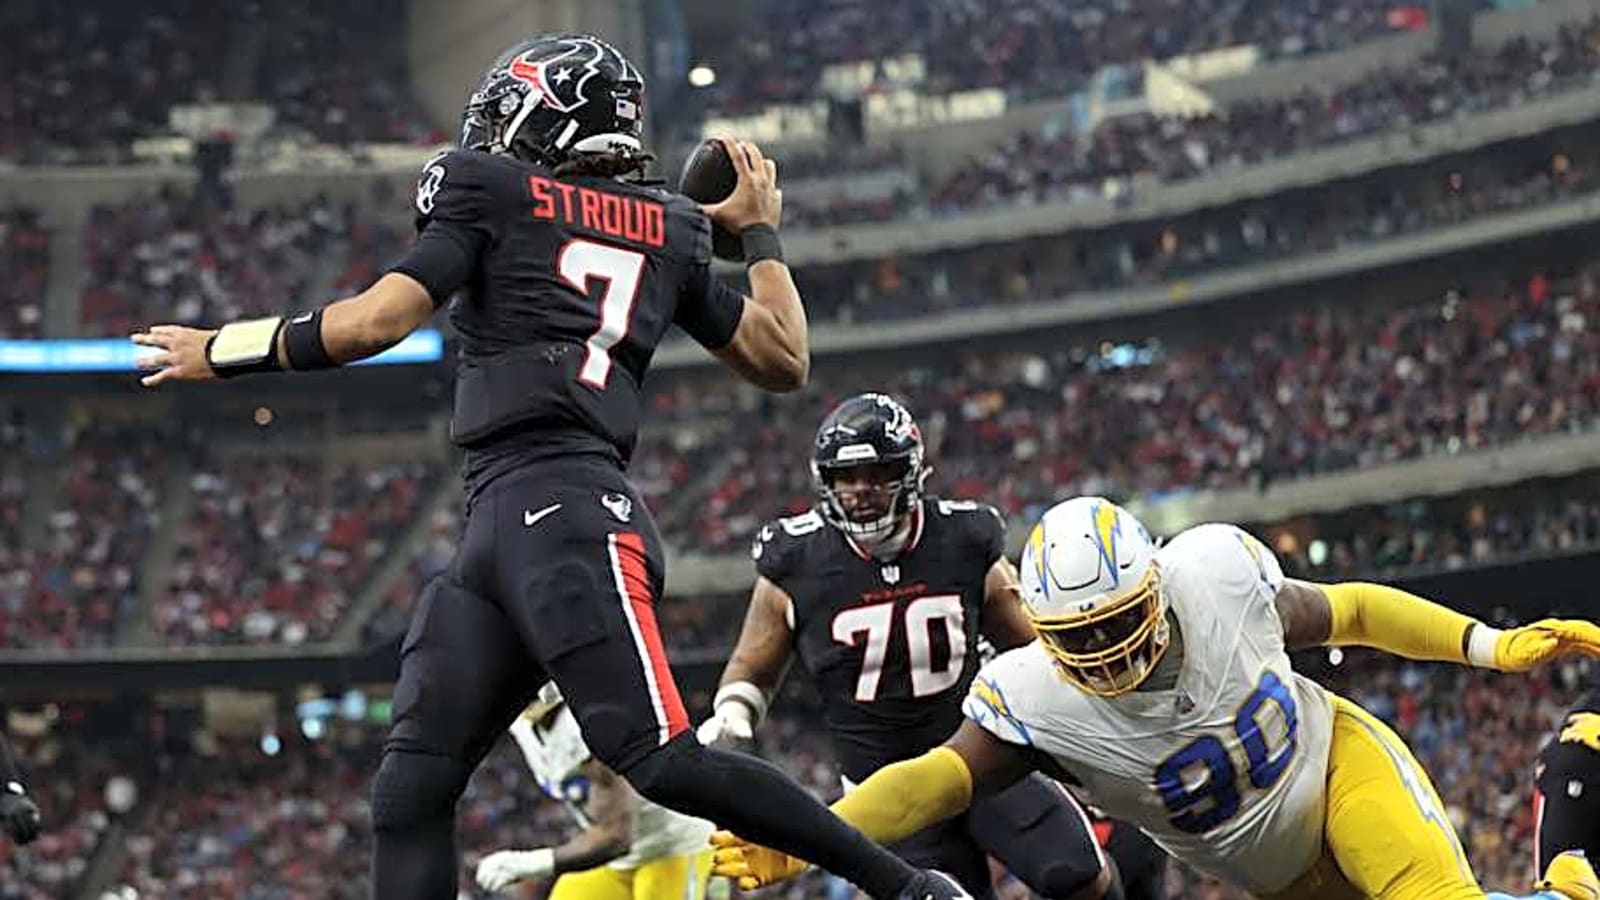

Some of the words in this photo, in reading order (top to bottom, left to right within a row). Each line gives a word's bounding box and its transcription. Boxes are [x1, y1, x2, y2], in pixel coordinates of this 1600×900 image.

[530, 175, 665, 247] STROUD
[556, 237, 646, 391] 7
[831, 594, 967, 701] 70
[1155, 670, 1297, 833] 90
